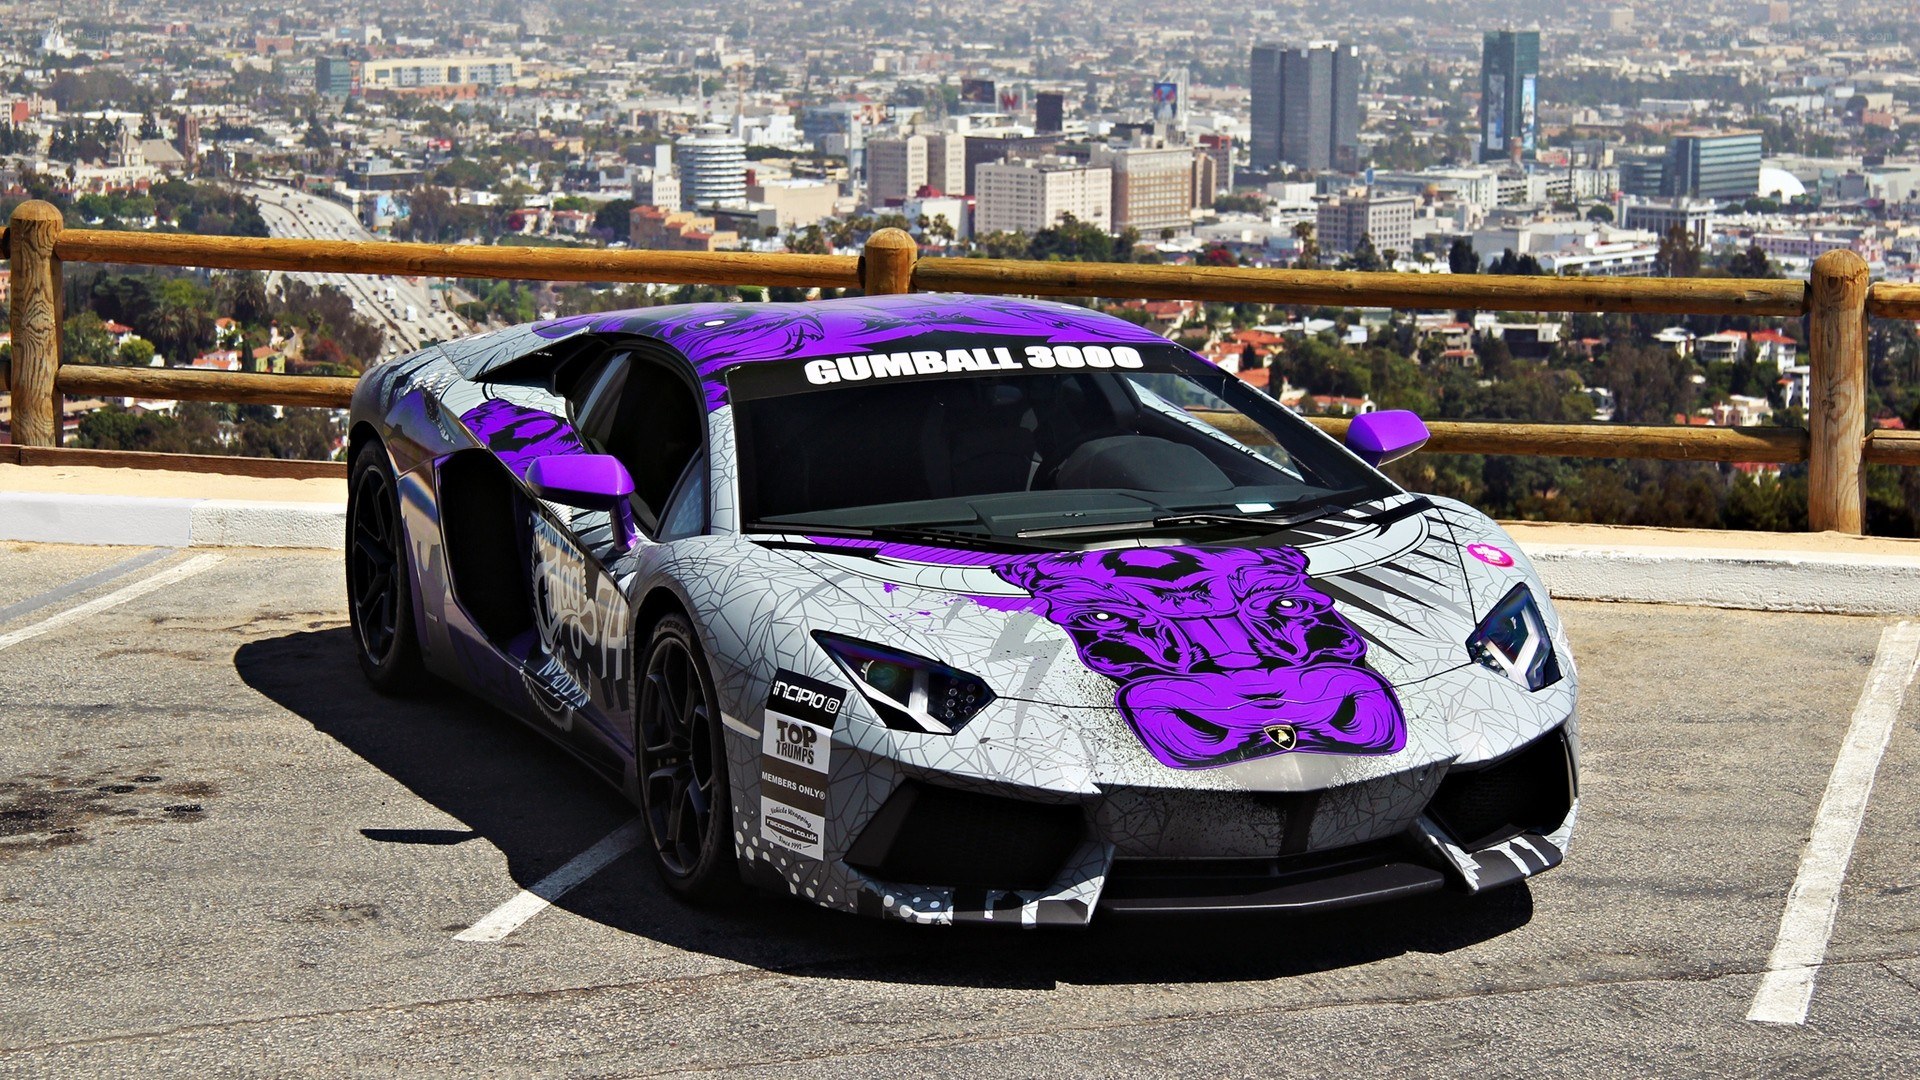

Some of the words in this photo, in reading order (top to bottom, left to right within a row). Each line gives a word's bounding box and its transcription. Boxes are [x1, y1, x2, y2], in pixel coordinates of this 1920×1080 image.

[804, 346, 1023, 385] GUMBALL
[1025, 346, 1144, 369] 3000
[777, 720, 817, 748] TOP
[776, 740, 814, 765] TRUMPS
[761, 771, 797, 791] MEMBERS
[766, 818, 818, 842] raccoon.co.uk
